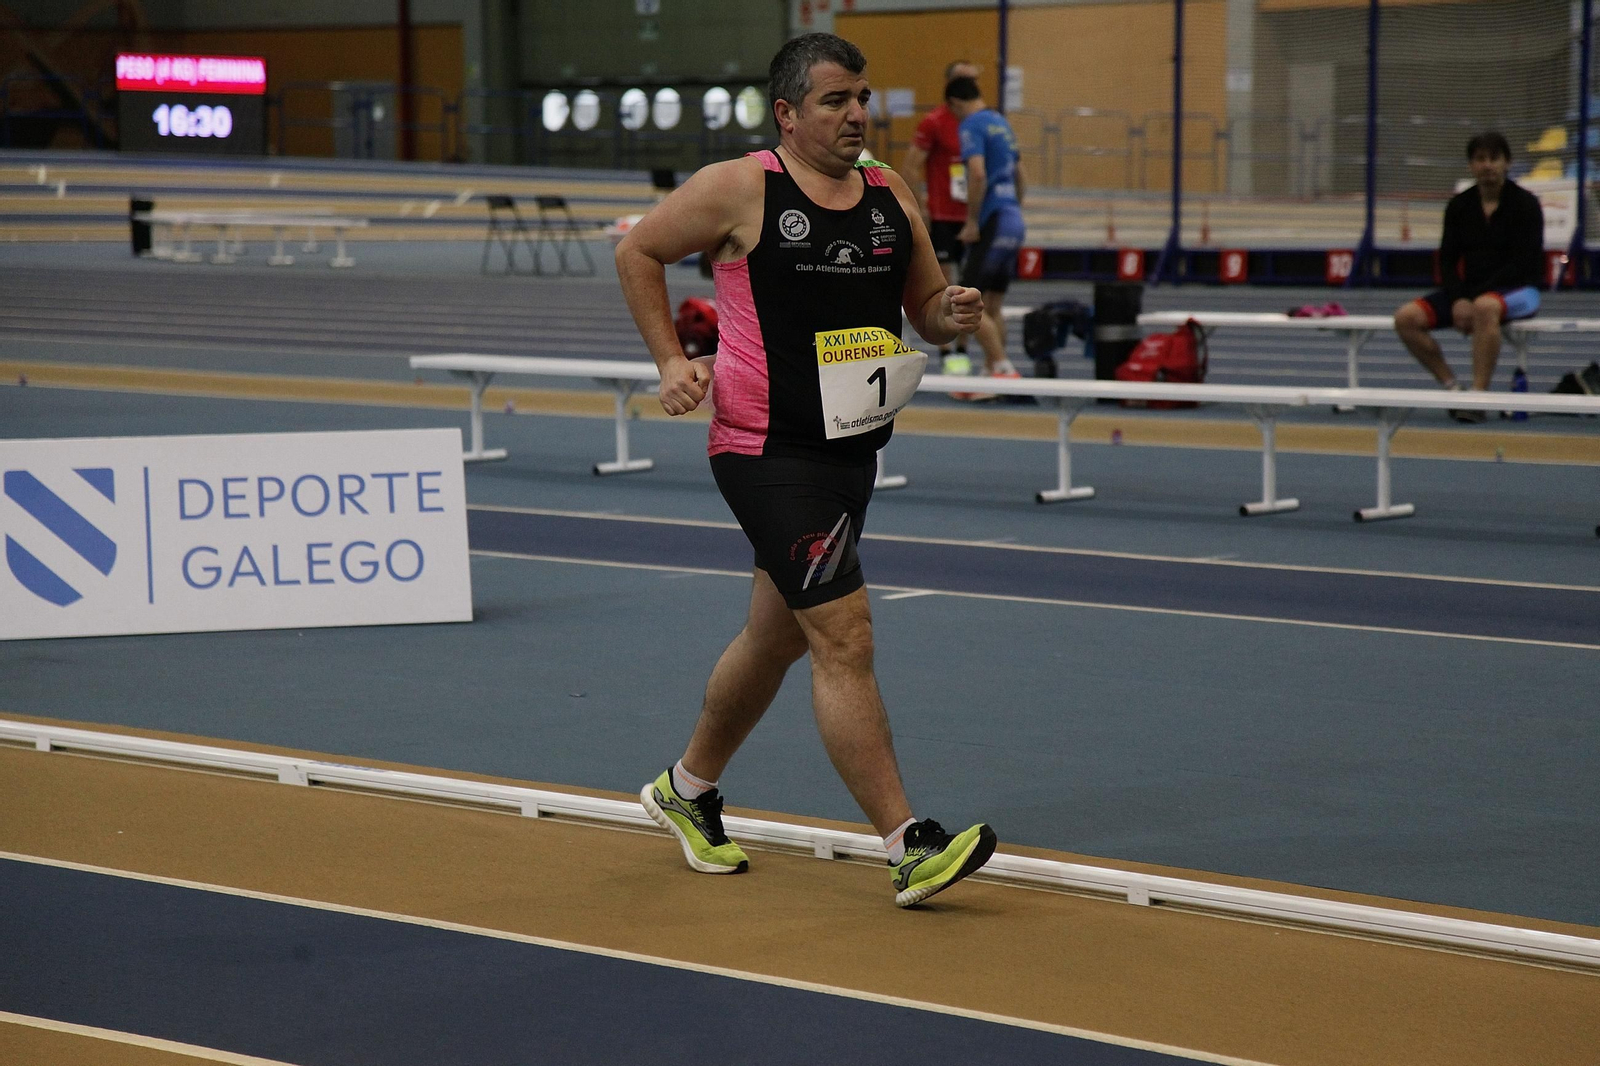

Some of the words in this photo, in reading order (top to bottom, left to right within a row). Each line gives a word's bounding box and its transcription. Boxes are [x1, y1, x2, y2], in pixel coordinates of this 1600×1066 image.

[152, 103, 233, 139] 16:30
[815, 264, 851, 274] Atletismo
[867, 265, 891, 273] Baixas
[1025, 251, 1039, 275] 7
[822, 344, 886, 363] OURENSE
[823, 333, 845, 348] XXI
[849, 330, 892, 345] MASTE
[866, 366, 887, 408] 1
[178, 471, 444, 520] DEPORTE
[181, 538, 425, 589] GALEGO
